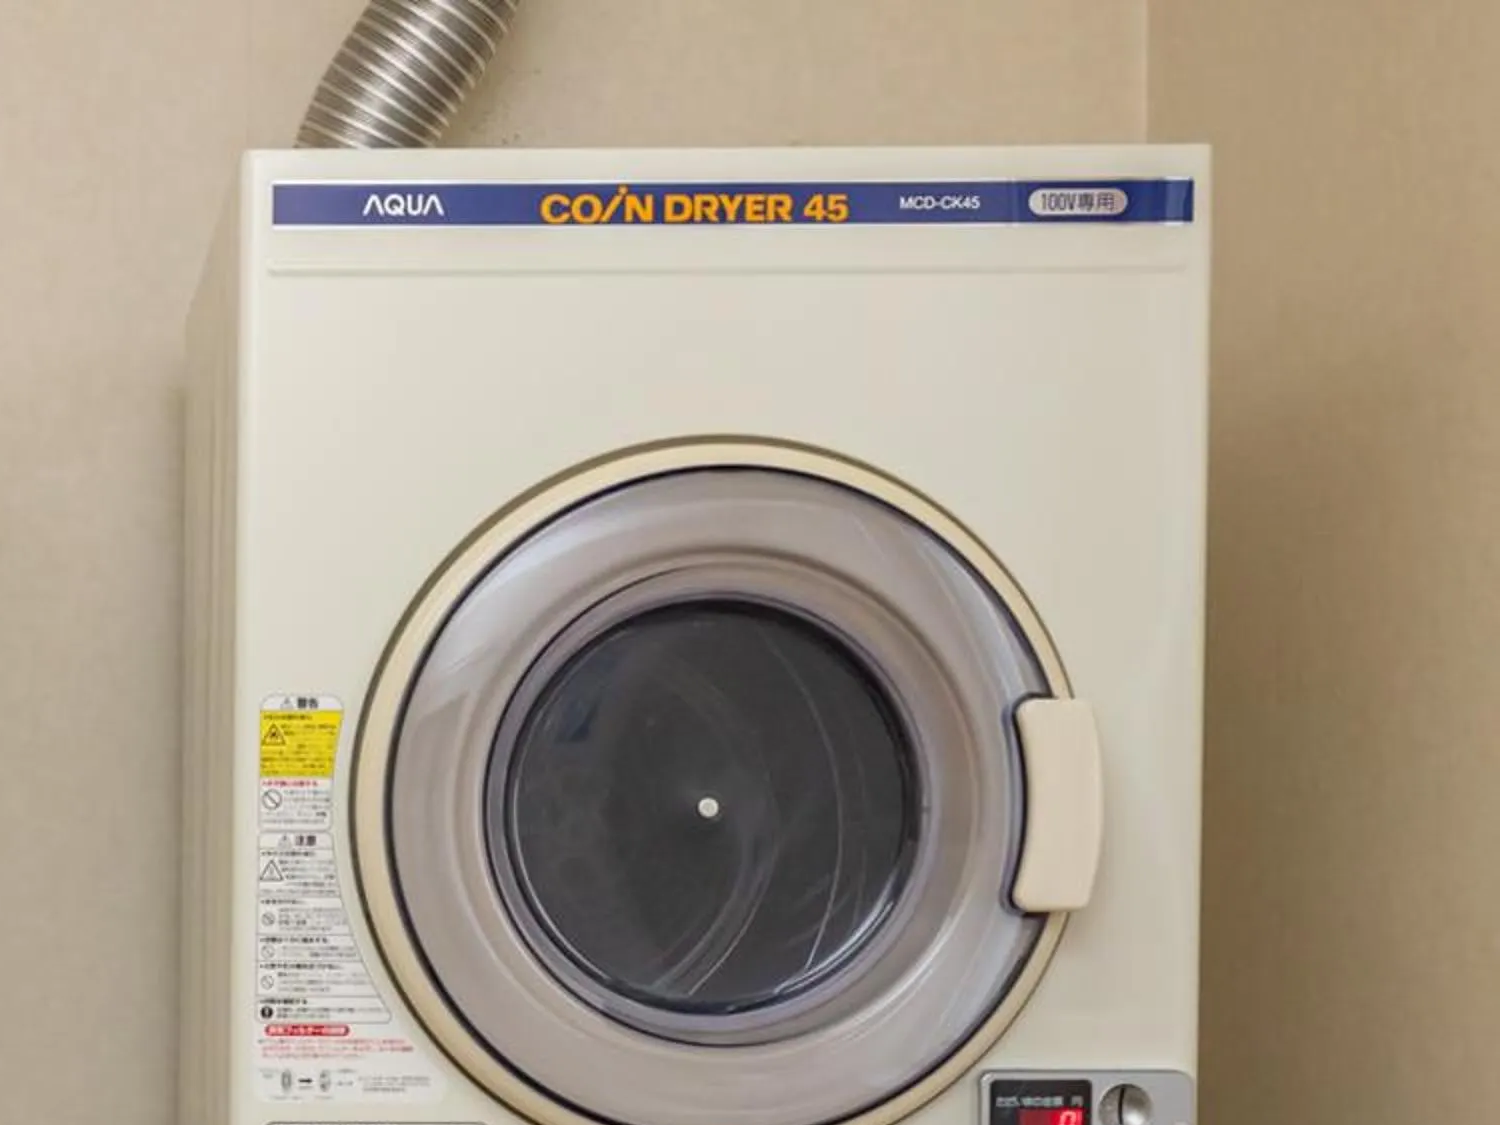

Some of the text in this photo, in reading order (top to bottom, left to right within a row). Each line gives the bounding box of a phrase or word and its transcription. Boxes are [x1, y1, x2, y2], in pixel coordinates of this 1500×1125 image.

[362, 194, 445, 216] AQUA
[665, 194, 792, 222] DRYER
[803, 194, 848, 222] 45
[899, 195, 981, 210] MCD-CK45
